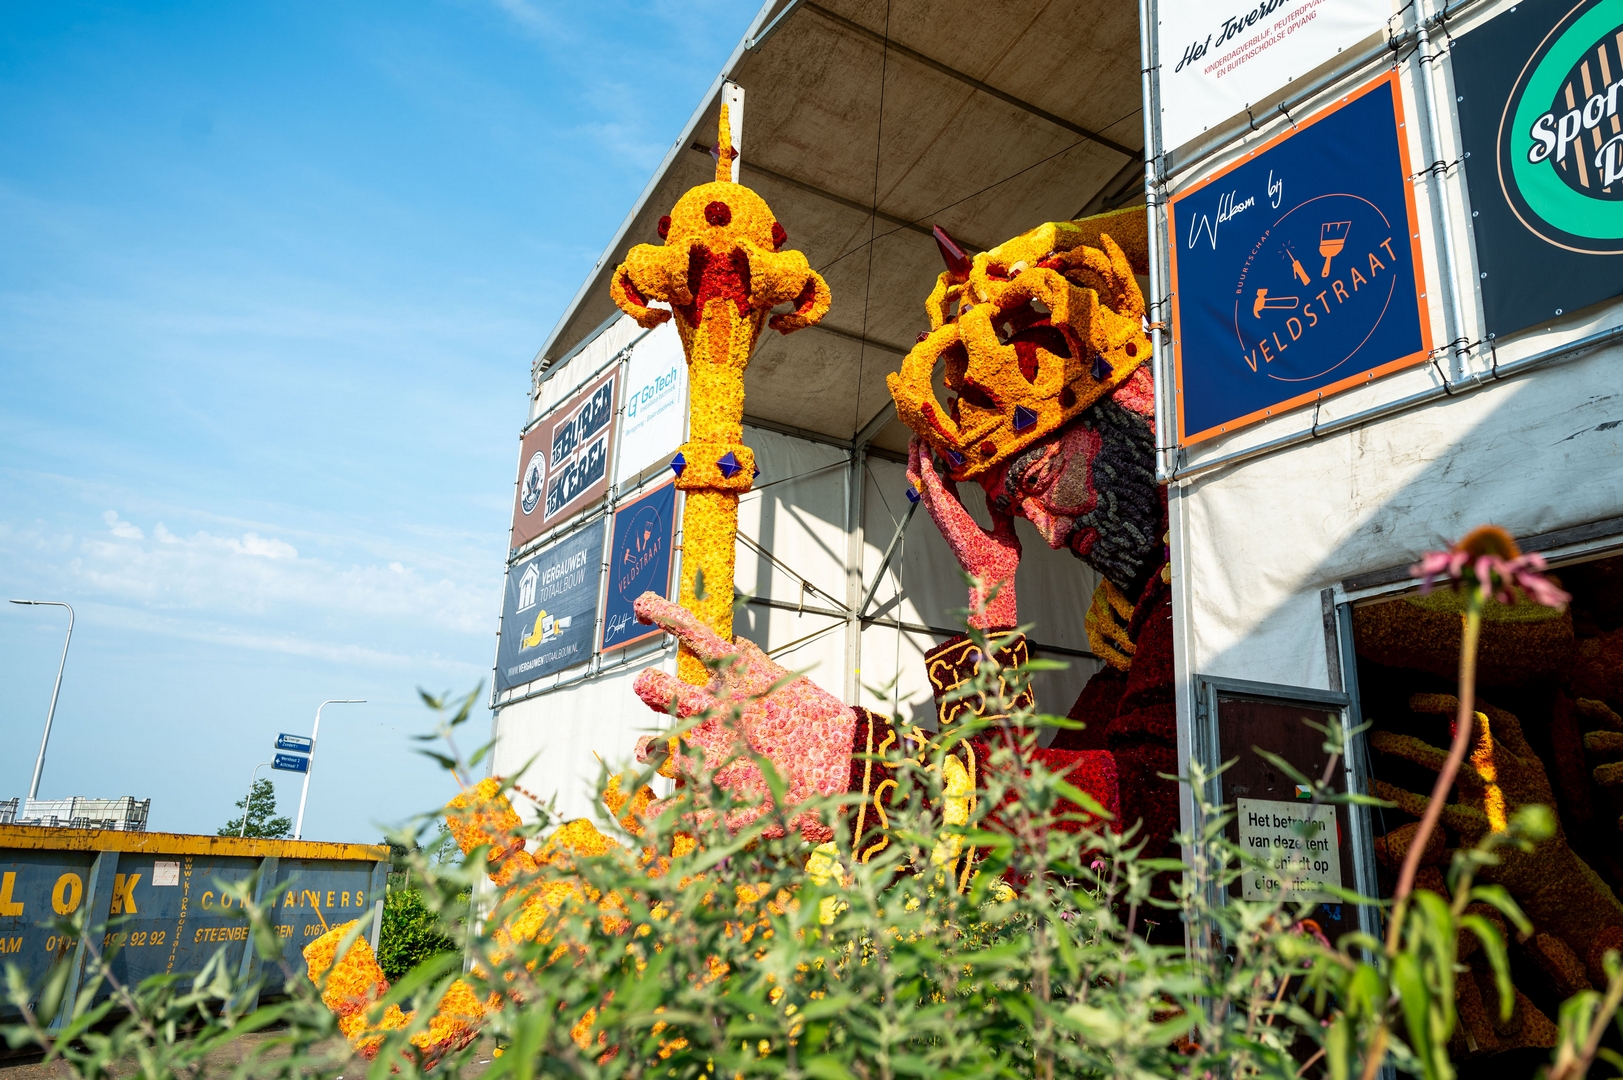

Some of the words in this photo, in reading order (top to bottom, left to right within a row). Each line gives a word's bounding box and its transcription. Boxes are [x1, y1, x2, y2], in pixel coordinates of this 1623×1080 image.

[1175, 34, 1212, 73] Het
[1204, 28, 1273, 75] KINDERDAGVERBLIJF,
[1216, 66, 1226, 79] EN
[1227, 30, 1286, 73] BUITENSCHOOLSE
[1287, 10, 1317, 35] OPVANG
[1268, 169, 1282, 209] bij
[1236, 229, 1271, 294] BUURTSCHAP
[1244, 237, 1397, 373] VELDSTRAAT
[642, 366, 677, 404] GoTech
[542, 549, 588, 586] VERGAUWEN
[618, 536, 662, 594] VELDSTRAAT
[540, 567, 586, 603] TOTAALBOUW
[1248, 812, 1270, 827] Het
[1248, 836, 1270, 848] van
[1273, 835, 1302, 849] deze
[1305, 838, 1329, 851] tent
[1254, 875, 1289, 893] eige
[1314, 860, 1329, 875] op
[130, 931, 147, 947] 92
[149, 931, 166, 946] 92
[194, 925, 294, 943] STEENBEGEN
